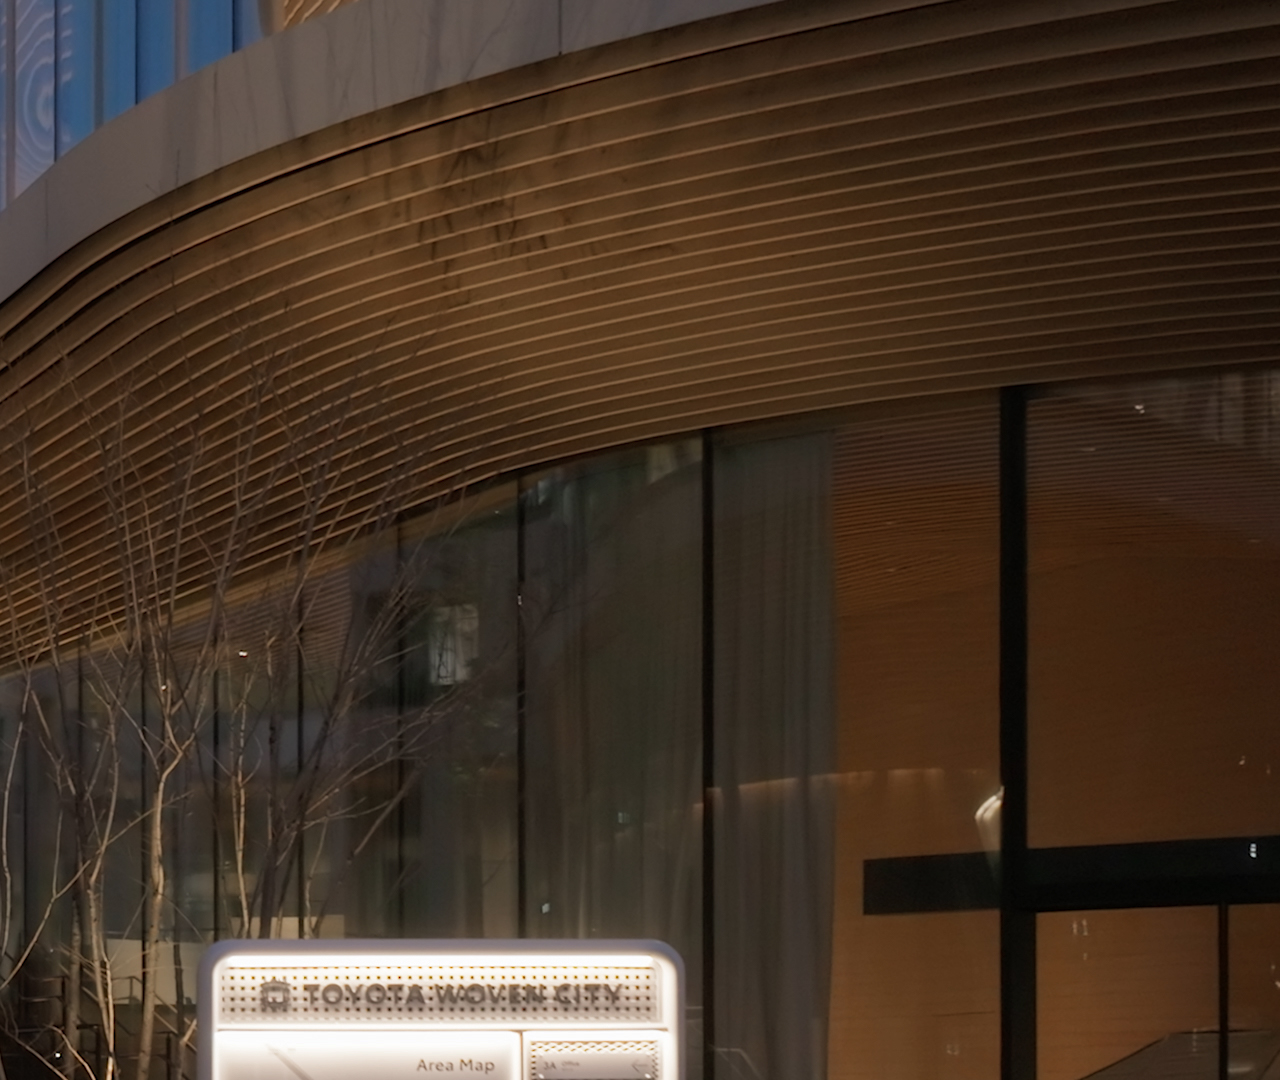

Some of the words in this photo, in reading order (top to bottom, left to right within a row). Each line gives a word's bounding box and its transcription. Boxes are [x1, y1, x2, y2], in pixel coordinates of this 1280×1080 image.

[303, 983, 427, 1005] TOYOTA
[434, 983, 543, 1005] WOVEN
[555, 983, 624, 1004] CITY
[416, 1059, 454, 1072] Area
[459, 1059, 496, 1075] Map
